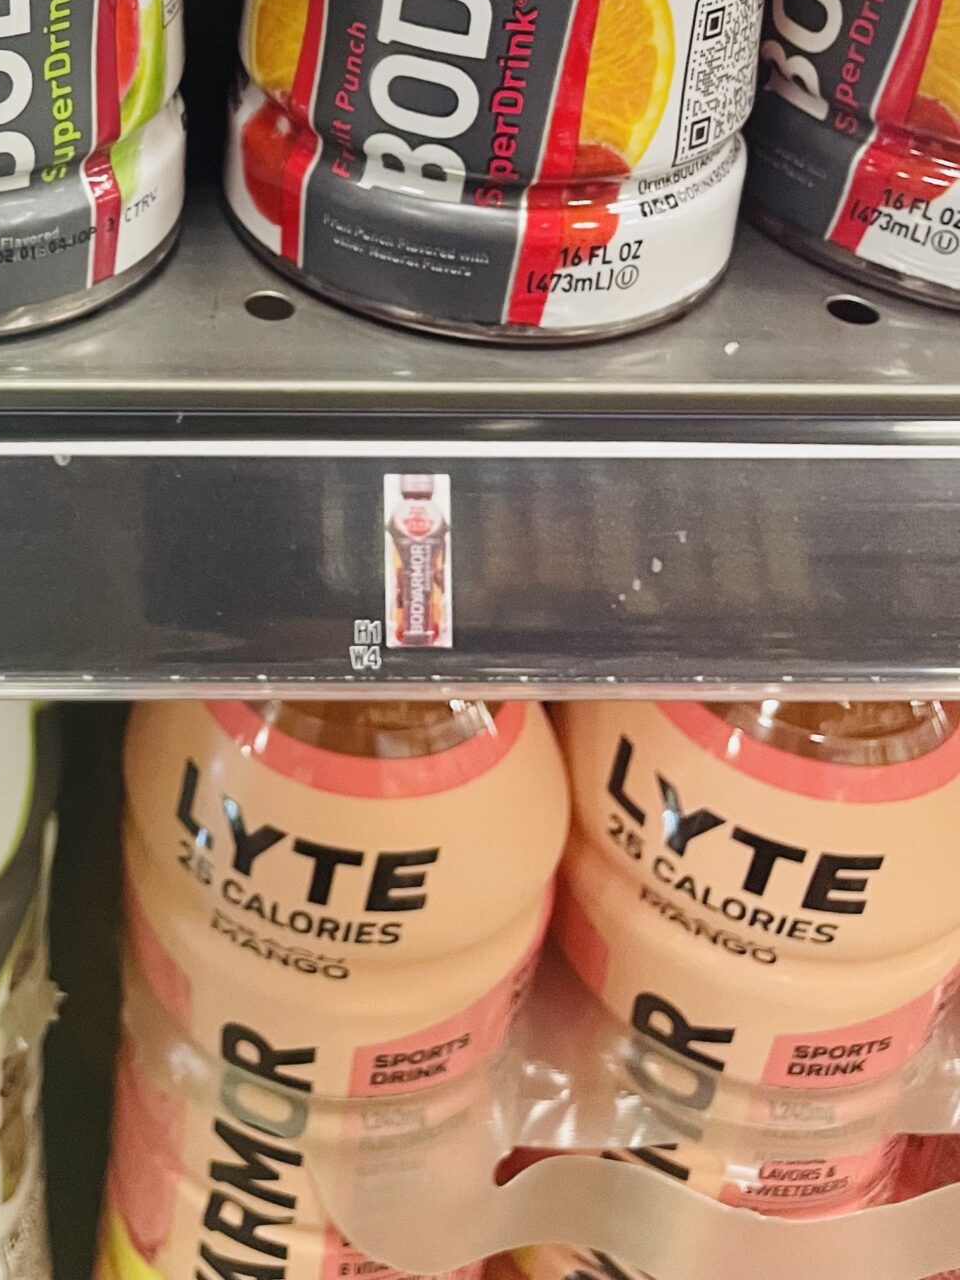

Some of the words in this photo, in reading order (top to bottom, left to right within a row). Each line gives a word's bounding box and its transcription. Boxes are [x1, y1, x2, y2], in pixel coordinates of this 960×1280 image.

[336, 21, 368, 113] Punch
[883, 188, 905, 210] 16
[908, 197, 933, 222] FL
[560, 247, 584, 268] 16
[589, 243, 613, 266] FL
[619, 239, 644, 263] OZ
[175, 756, 440, 913] LYTE
[607, 734, 885, 915] LYTE
[177, 838, 214, 887] 25
[221, 876, 403, 946] CALORIES
[607, 813, 643, 861] 25
[651, 855, 840, 944] CALORIES
[373, 1032, 471, 1069] SPORTS
[792, 1035, 894, 1060] SPORTS
[369, 1057, 447, 1086] DRINK
[785, 1059, 866, 1077] DRINK
